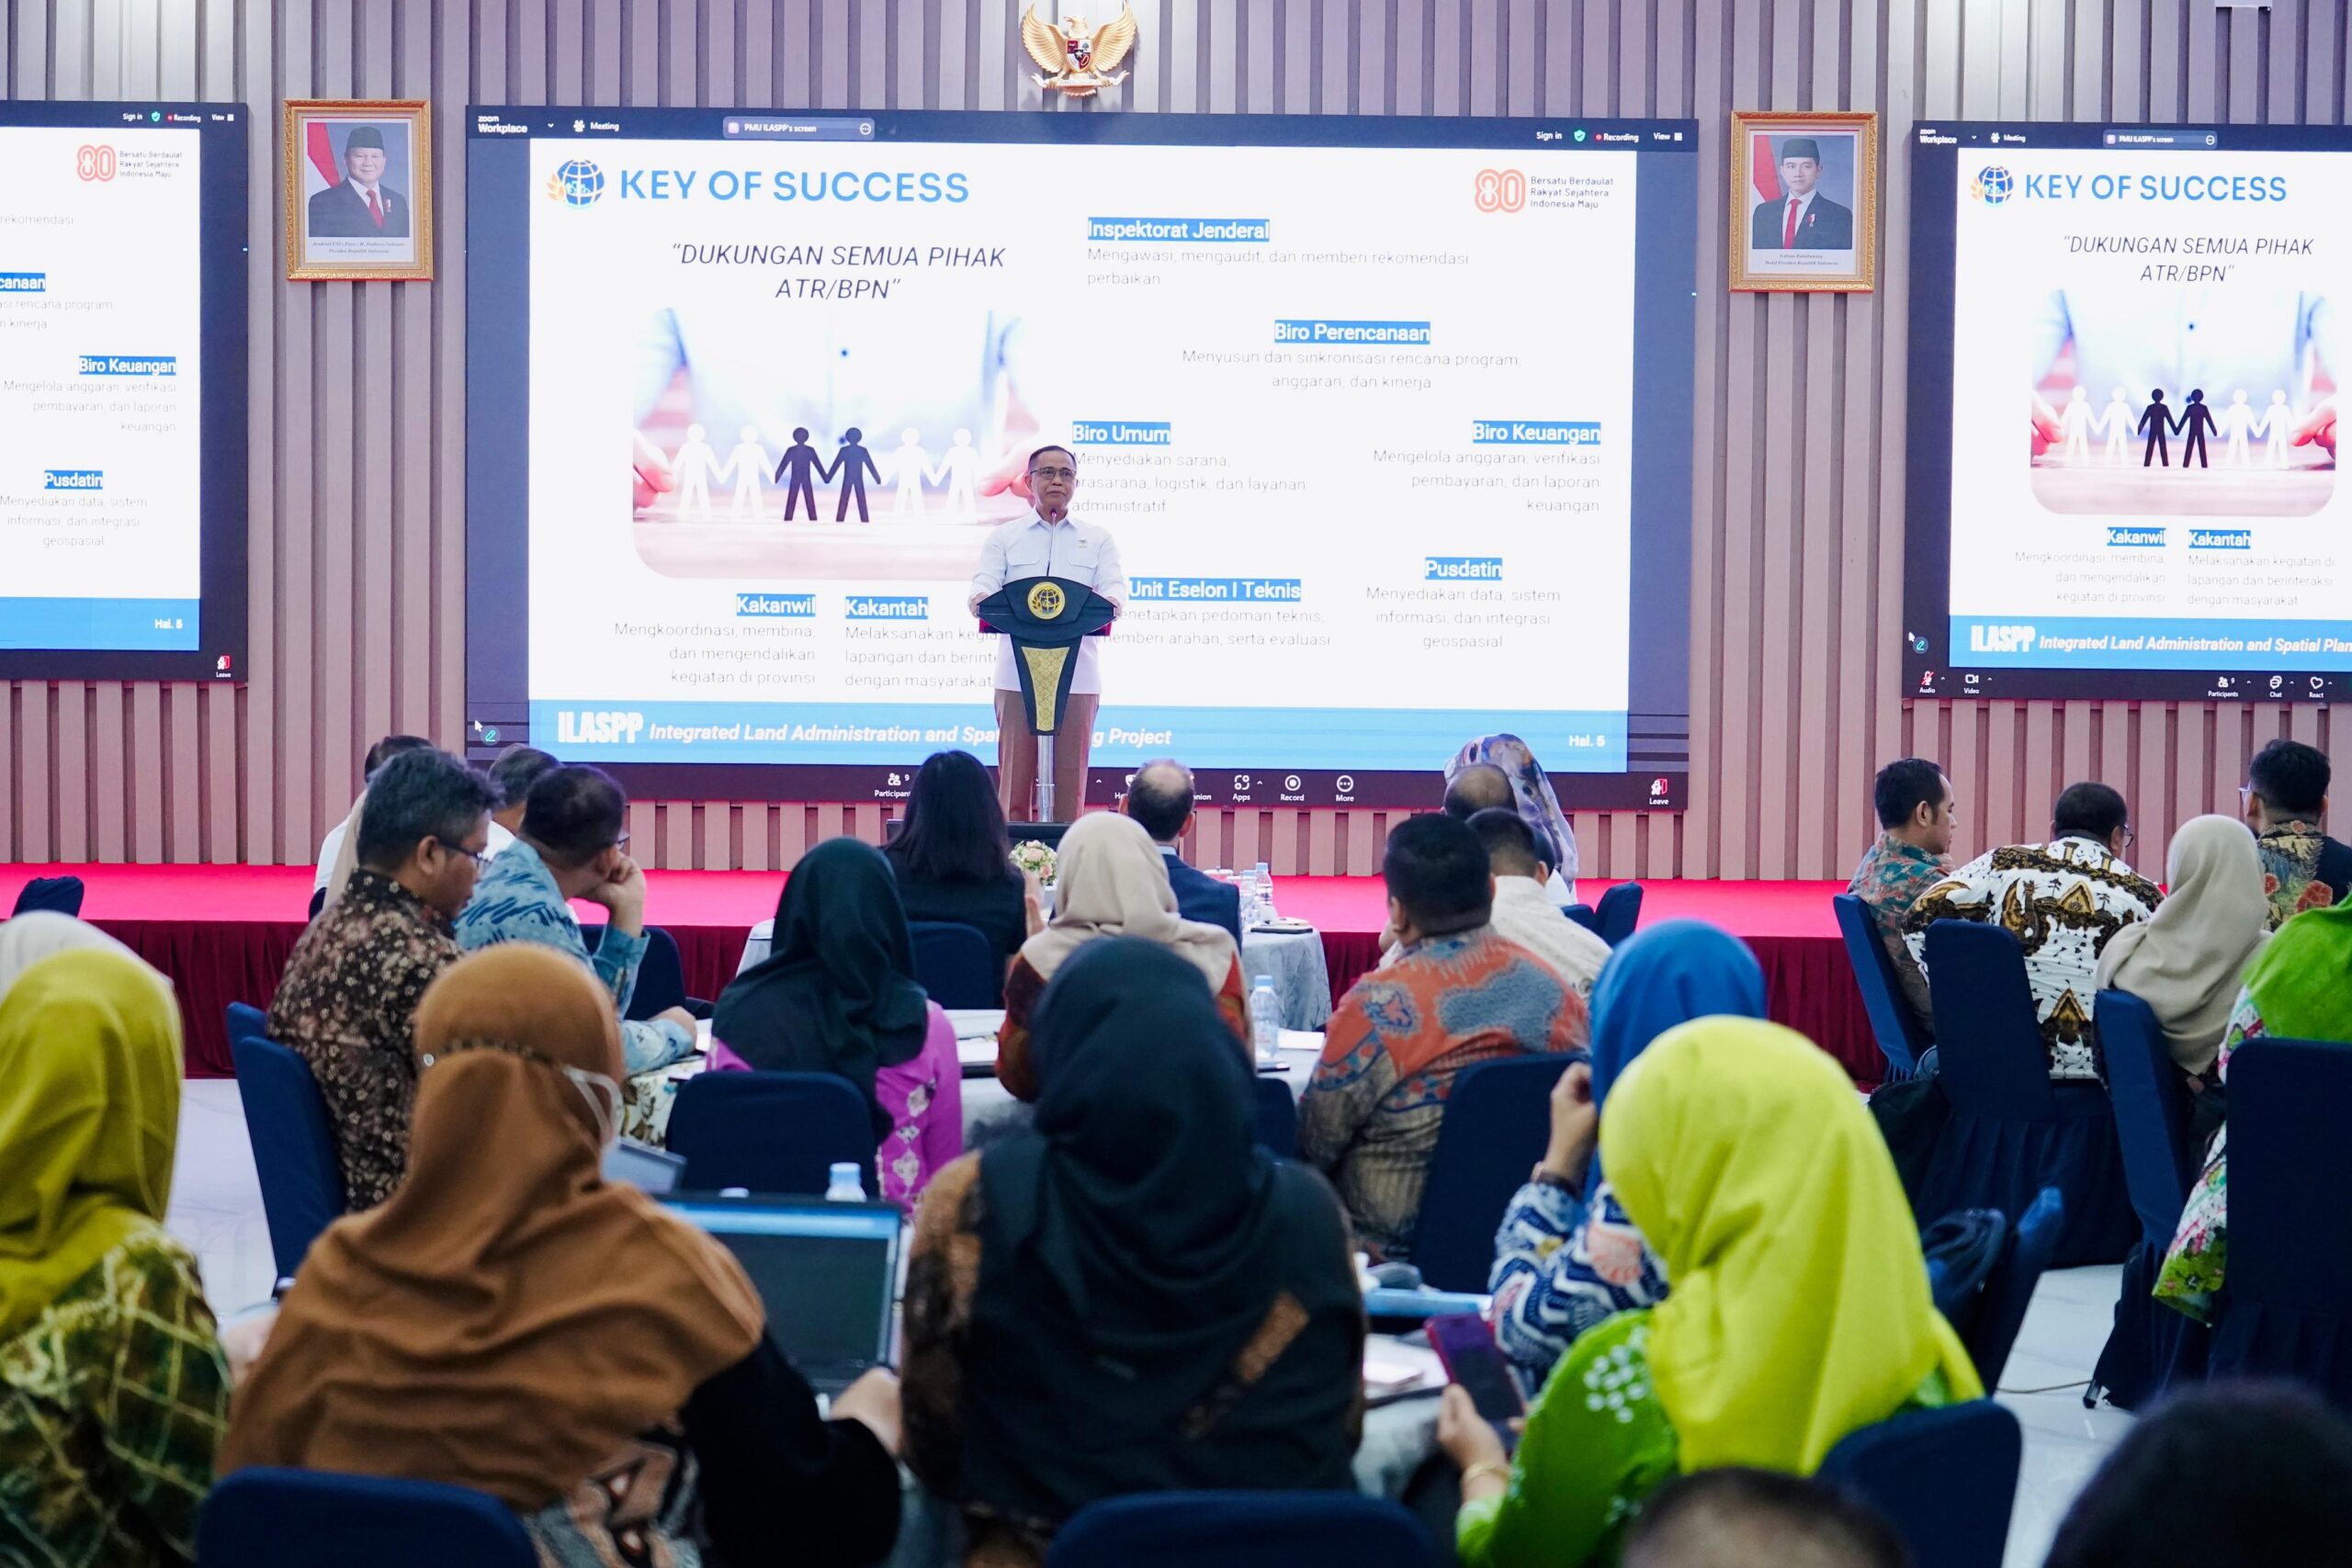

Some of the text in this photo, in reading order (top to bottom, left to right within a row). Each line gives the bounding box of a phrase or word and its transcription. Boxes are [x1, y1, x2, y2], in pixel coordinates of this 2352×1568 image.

[478, 115, 500, 123] zoom
[590, 121, 620, 132] Meeting
[479, 124, 527, 134] Workplace
[743, 122, 763, 133] PMU
[794, 126, 817, 134] screen
[1536, 130, 1563, 141] Sign in
[1602, 132, 1640, 143] Recording
[1653, 132, 1671, 141] View
[621, 170, 968, 203] KEY OF SUCCESS
[1530, 175, 1614, 186] Bersatu Berdaulat
[1531, 187, 1609, 198] Rakyat Sejahtera
[2026, 175, 2287, 202] KEY OF SUCCESS
[1530, 198, 1599, 210] Indonesia Maju
[1088, 220, 1269, 239] Inspektorat Jenderal
[2183, 238, 2248, 254] SEMUA
[2256, 239, 2313, 254] PIHAK
[831, 246, 918, 265] SEMUA
[928, 247, 1005, 266] PIHAK
[1269, 250, 1296, 263] dan
[1302, 251, 1366, 263] memberi
[1373, 251, 1468, 265] rekomendasi
[1088, 272, 1160, 287] perbaikan
[1274, 322, 1430, 342] Biro Perencanaan
[1183, 349, 1260, 367] Menyusun
[1264, 350, 1293, 363] dan
[1297, 348, 1385, 364] sinkronisasi
[1391, 353, 1450, 365] rencana
[80, 359, 176, 374] Biro Keuangan
[1350, 375, 1379, 388] dan
[1383, 375, 1431, 391] kinerja
[1073, 424, 1170, 443] Biro Umum
[1473, 424, 1600, 443] Biro Keuangan
[1374, 449, 1450, 466] Mengelola
[1534, 450, 1600, 464] verifikasi
[45, 473, 103, 487] Pusdatin
[1216, 478, 1243, 490] dan
[1249, 478, 1306, 492] layanan
[1512, 474, 1539, 487] dan
[1544, 474, 1600, 491] laporan
[1072, 499, 1167, 513] administratif
[1527, 499, 1599, 514] keuangan
[2108, 531, 2165, 545] Kakanwil
[2189, 533, 2250, 547] Kakantah
[1425, 561, 1502, 578] Pusdatin
[1129, 581, 1164, 598] Unit
[1168, 581, 1227, 598] Eselon
[1241, 581, 1301, 599] Teknis
[1367, 587, 1464, 603] Menyediakan
[1511, 590, 1560, 603] sistem
[737, 596, 816, 615] Kakanwil
[845, 600, 928, 617] Kakantah
[1203, 609, 1271, 624] pedoman
[1454, 611, 1481, 625] dan
[1487, 612, 1550, 627] integrasi
[845, 626, 954, 640] Melaksanakan
[1228, 634, 1264, 645] serta
[1270, 632, 1329, 647] evaluasi
[1971, 626, 2035, 651] ILASPP
[1423, 635, 1502, 650] geospasial
[2040, 636, 2321, 654] Integrated Land Administration and Spatial
[670, 647, 814, 662] dan mengendalikan
[845, 649, 945, 666] lapangan dan
[670, 670, 815, 685] kegiatan di provinsi
[845, 673, 899, 689] dengan
[559, 712, 643, 743] ILASPP
[650, 724, 959, 743] Integrated Land Administration and
[1109, 728, 1171, 748] Project
[1569, 735, 1605, 747] Hal. 5
[1232, 793, 1251, 803] Apps
[1280, 793, 1305, 802] Record
[1335, 794, 1354, 802] More
[1649, 797, 1669, 806] Leave
